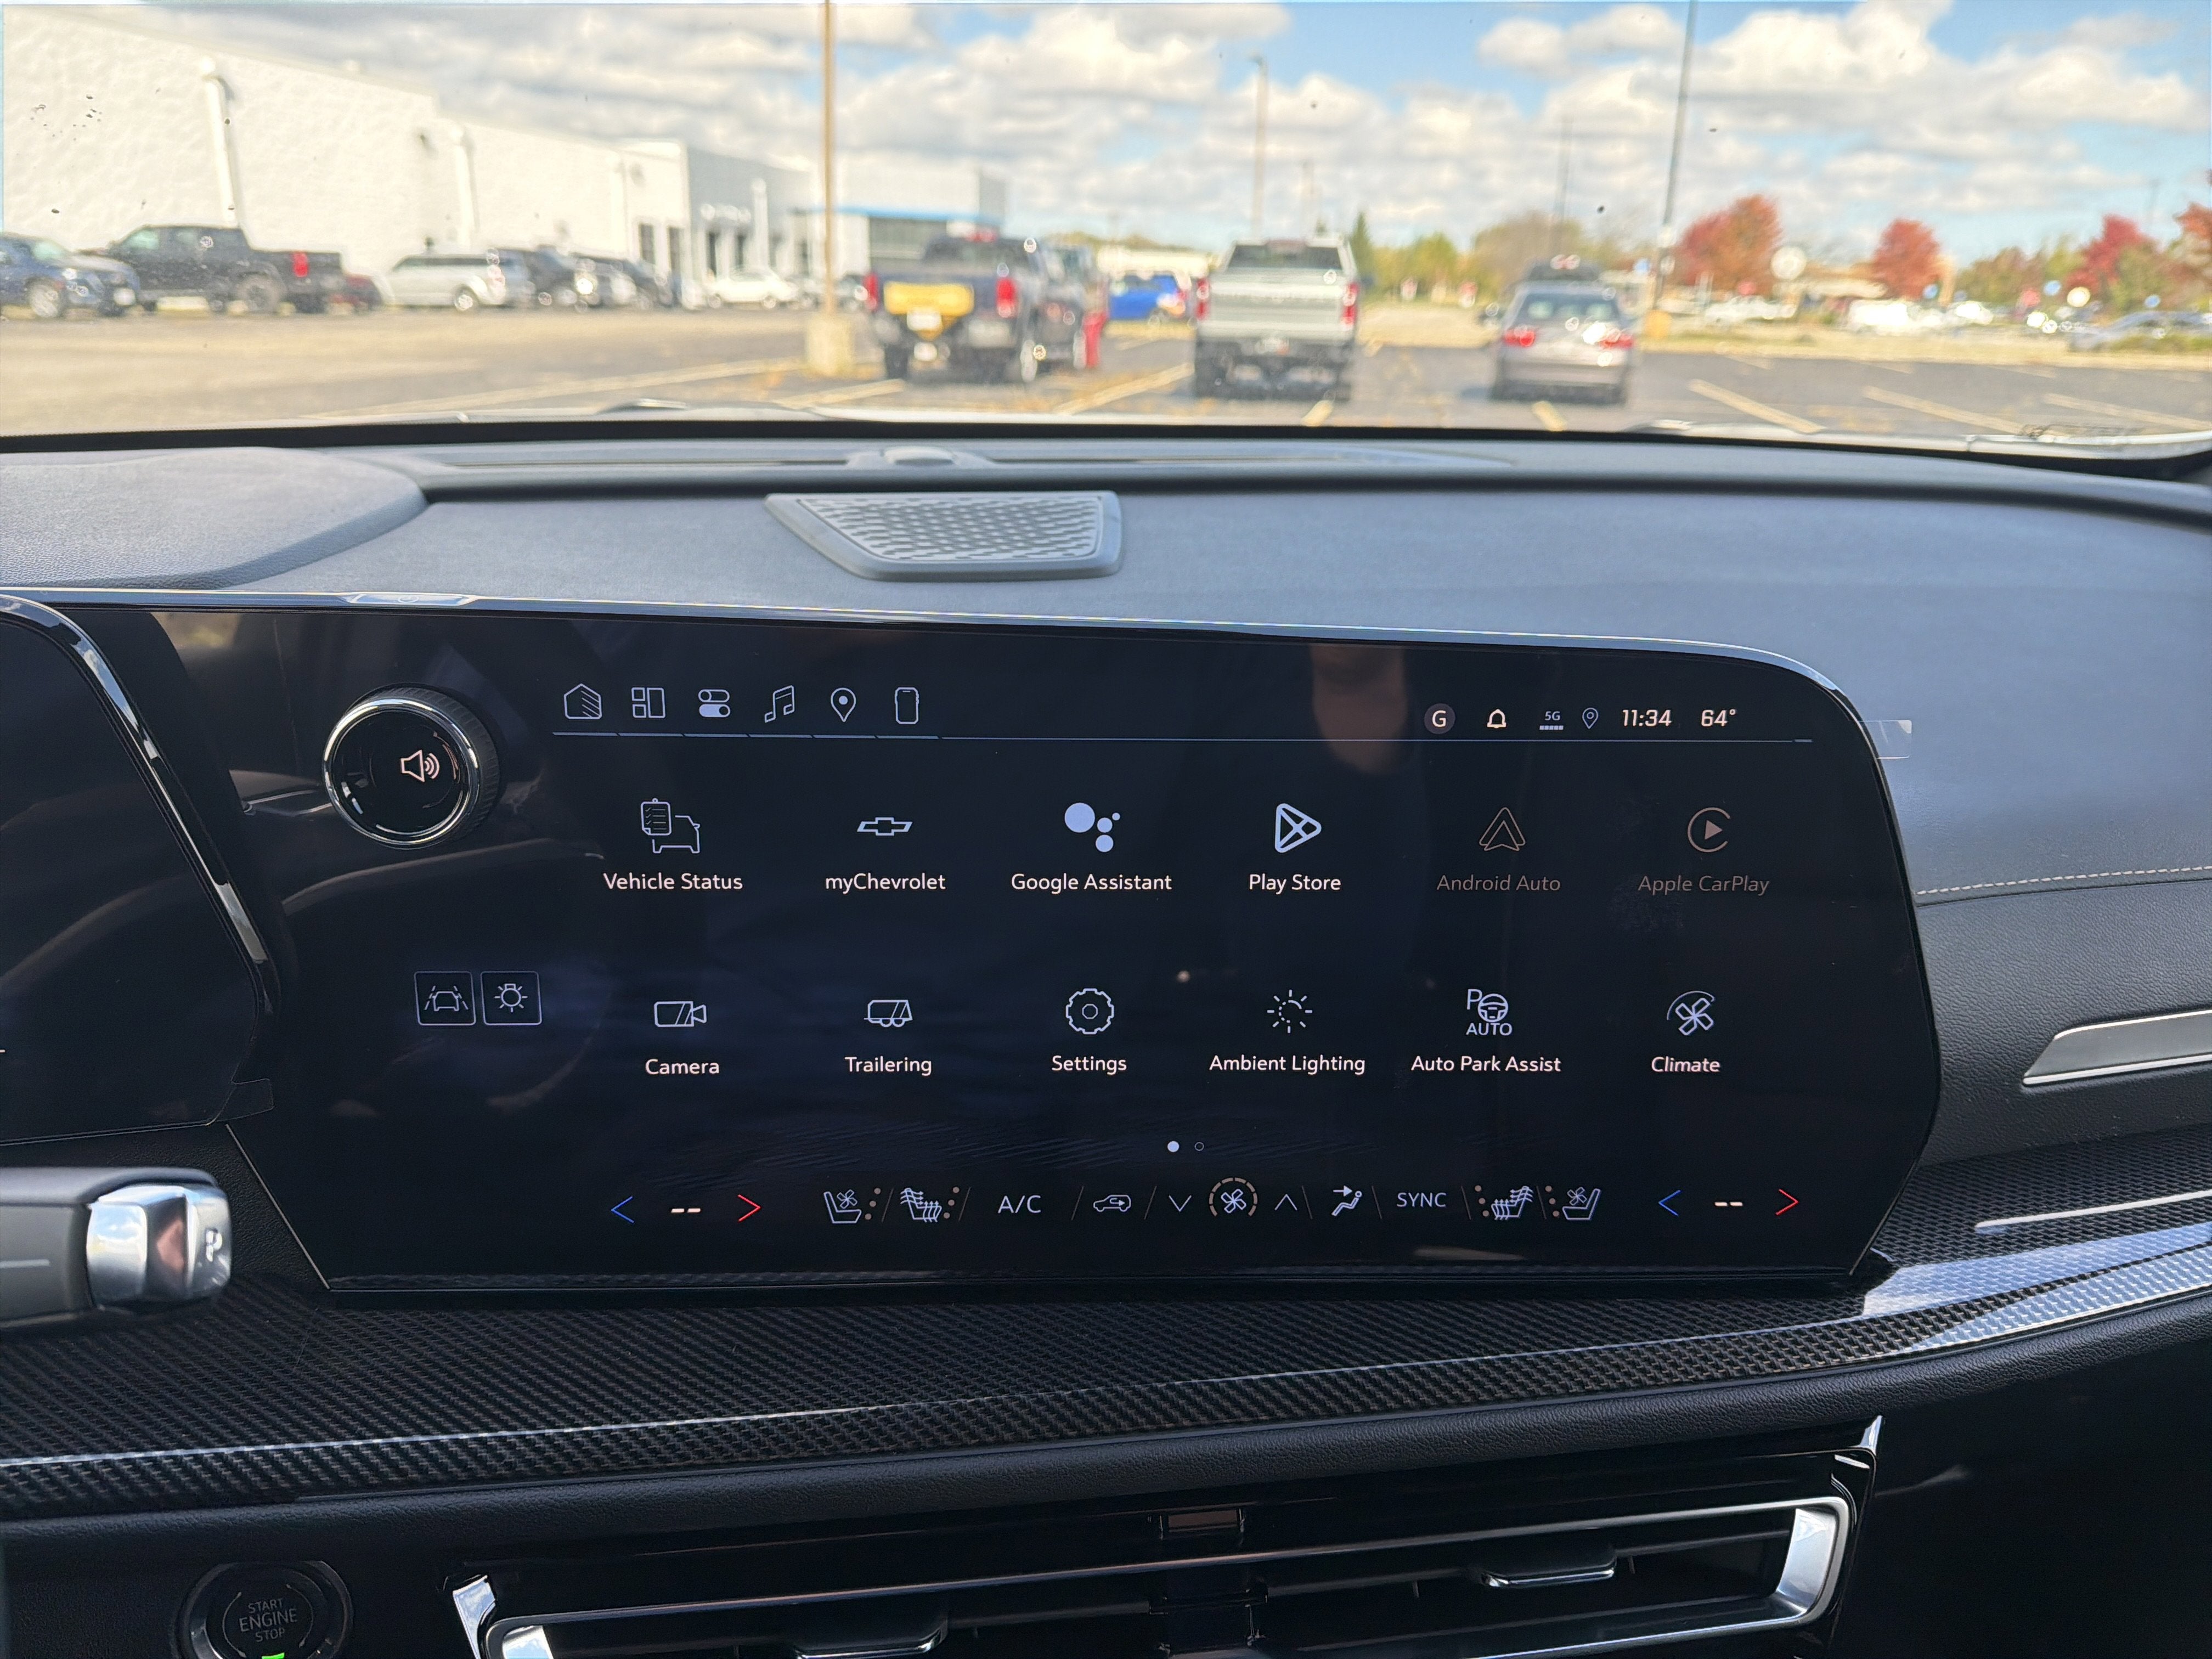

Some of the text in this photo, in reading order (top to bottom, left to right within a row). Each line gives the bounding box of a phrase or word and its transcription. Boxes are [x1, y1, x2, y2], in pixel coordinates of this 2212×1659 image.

[1432, 710, 1446, 727] G
[1544, 711, 1560, 721] 5G
[1622, 709, 1672, 726] 11:34
[603, 872, 743, 889] Vehicle Status
[826, 872, 946, 894] myChevrolet
[1011, 872, 1172, 894] Google Assistant
[1249, 873, 1341, 895] Play Store
[1436, 874, 1560, 891] Android Auto
[1638, 874, 1770, 896] Apple CarPlay
[1466, 989, 1482, 1010] P
[1466, 1023, 1513, 1036] AUTO
[645, 1059, 719, 1075] Camera
[844, 1056, 932, 1076] Trailering
[1052, 1055, 1127, 1075] Settings
[1209, 1054, 1365, 1075] Ambient Lighting
[1410, 1055, 1561, 1072] Auto Park Assist
[1651, 1056, 1720, 1072] Climate
[997, 1195, 1041, 1214] A/C
[1397, 1192, 1447, 1207] SYNC
[205, 1228, 223, 1262] P
[248, 1598, 283, 1613] START
[239, 1608, 297, 1632] ENGINE
[255, 1627, 285, 1642] STOP
